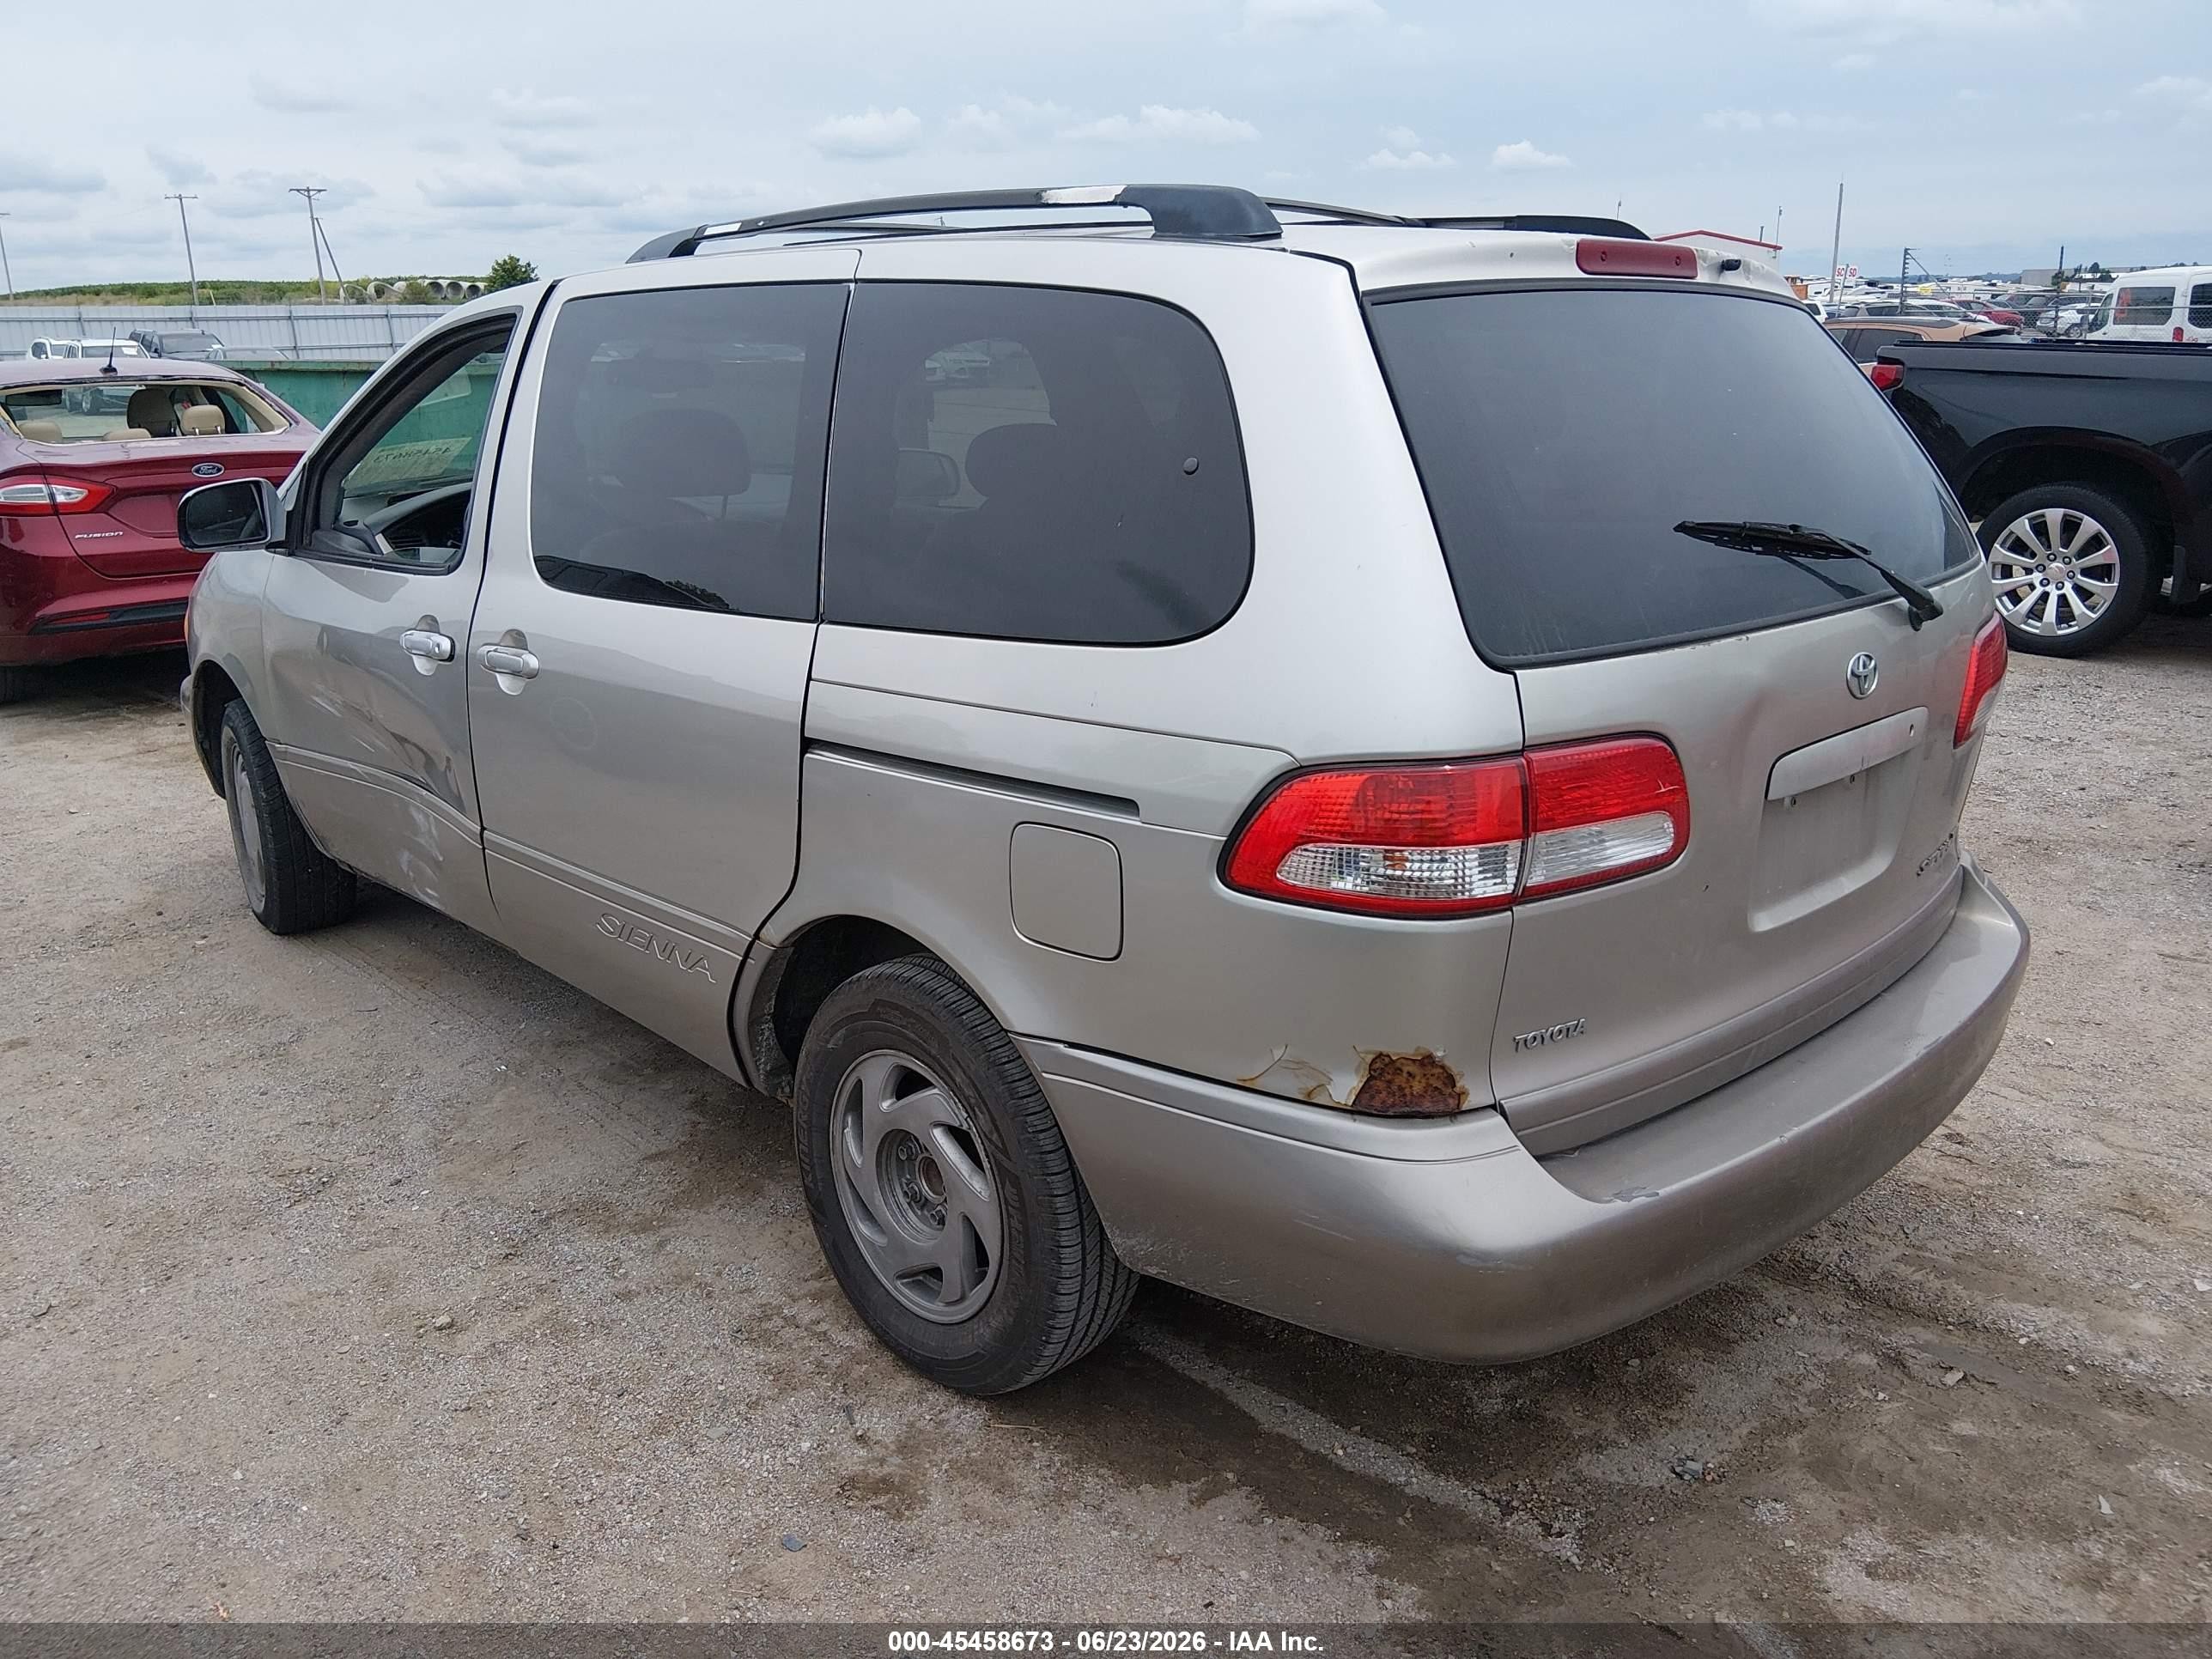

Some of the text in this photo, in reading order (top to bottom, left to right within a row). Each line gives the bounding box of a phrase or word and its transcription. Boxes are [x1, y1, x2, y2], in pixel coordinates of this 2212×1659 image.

[75, 530, 124, 539] FUSION
[595, 912, 717, 984] SIENNA
[1513, 1018, 1586, 1054] TOYOTA
